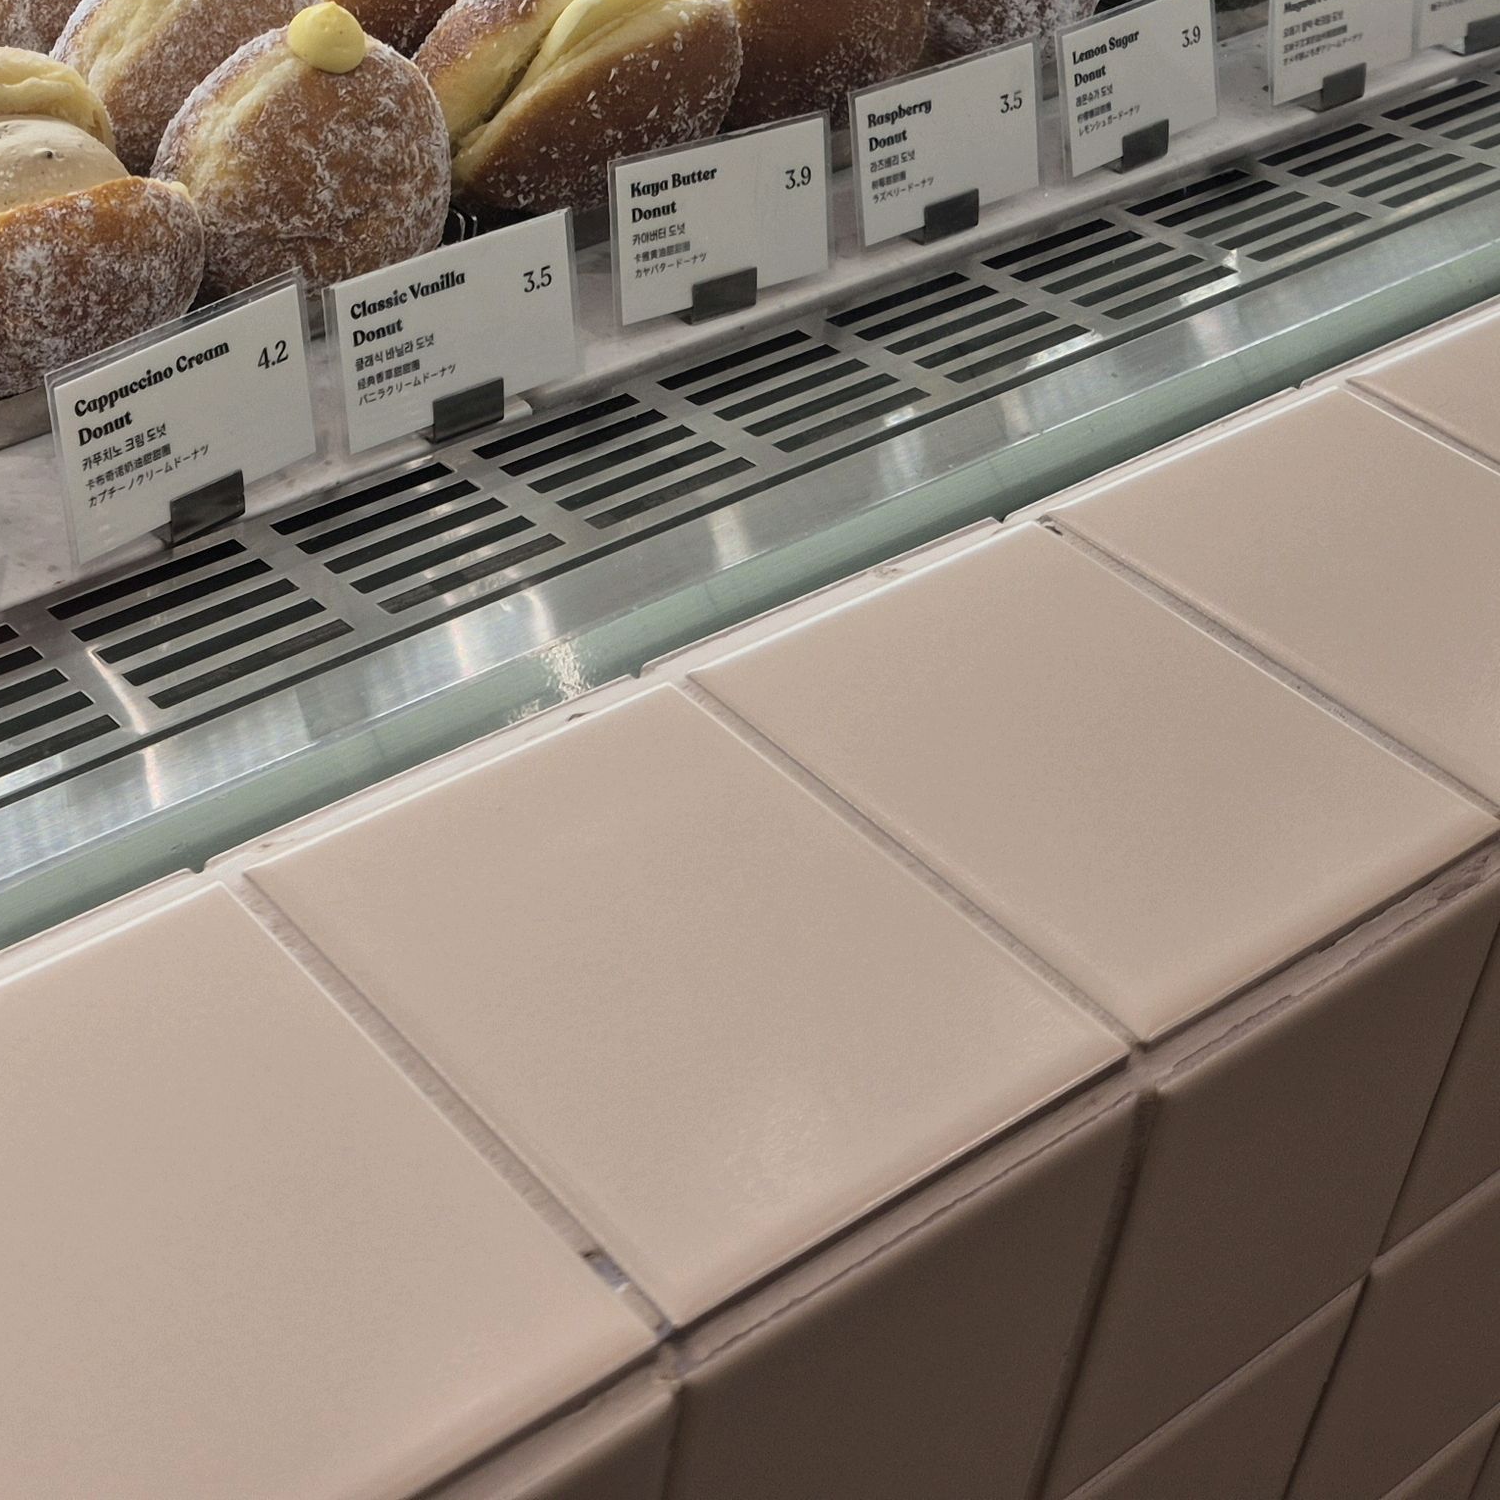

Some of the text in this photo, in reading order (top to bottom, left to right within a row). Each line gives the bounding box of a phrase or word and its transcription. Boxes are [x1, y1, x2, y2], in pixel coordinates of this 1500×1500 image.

[1071, 30, 1140, 66] Lemon Sugar
[1181, 25, 1201, 48] 3.9
[1073, 64, 1107, 88] Donut
[867, 99, 932, 129] Raspberry
[999, 89, 1023, 114] 3.5
[868, 129, 908, 153] Donut
[630, 167, 718, 199] Kaya Butter
[784, 165, 812, 190] 3.9
[631, 200, 677, 224] Donut
[632, 222, 686, 246] 카야버터 도넛
[522, 264, 553, 293] 3.5
[635, 251, 707, 279] カヤバタードーナツ
[350, 270, 466, 320] Classic Vanilla
[352, 318, 404, 348] Donut
[384, 339, 414, 361] 바닐라
[415, 332, 435, 351] 도넛
[257, 339, 289, 370] 4.2
[74, 342, 230, 418] Cappuccino Cream
[358, 363, 457, 407] バニラクリームドーナツ
[77, 411, 133, 447] Donut
[82, 422, 167, 472] 카푸치노 크림 도넛
[88, 443, 209, 509] カプチーノクリームドーナツ
